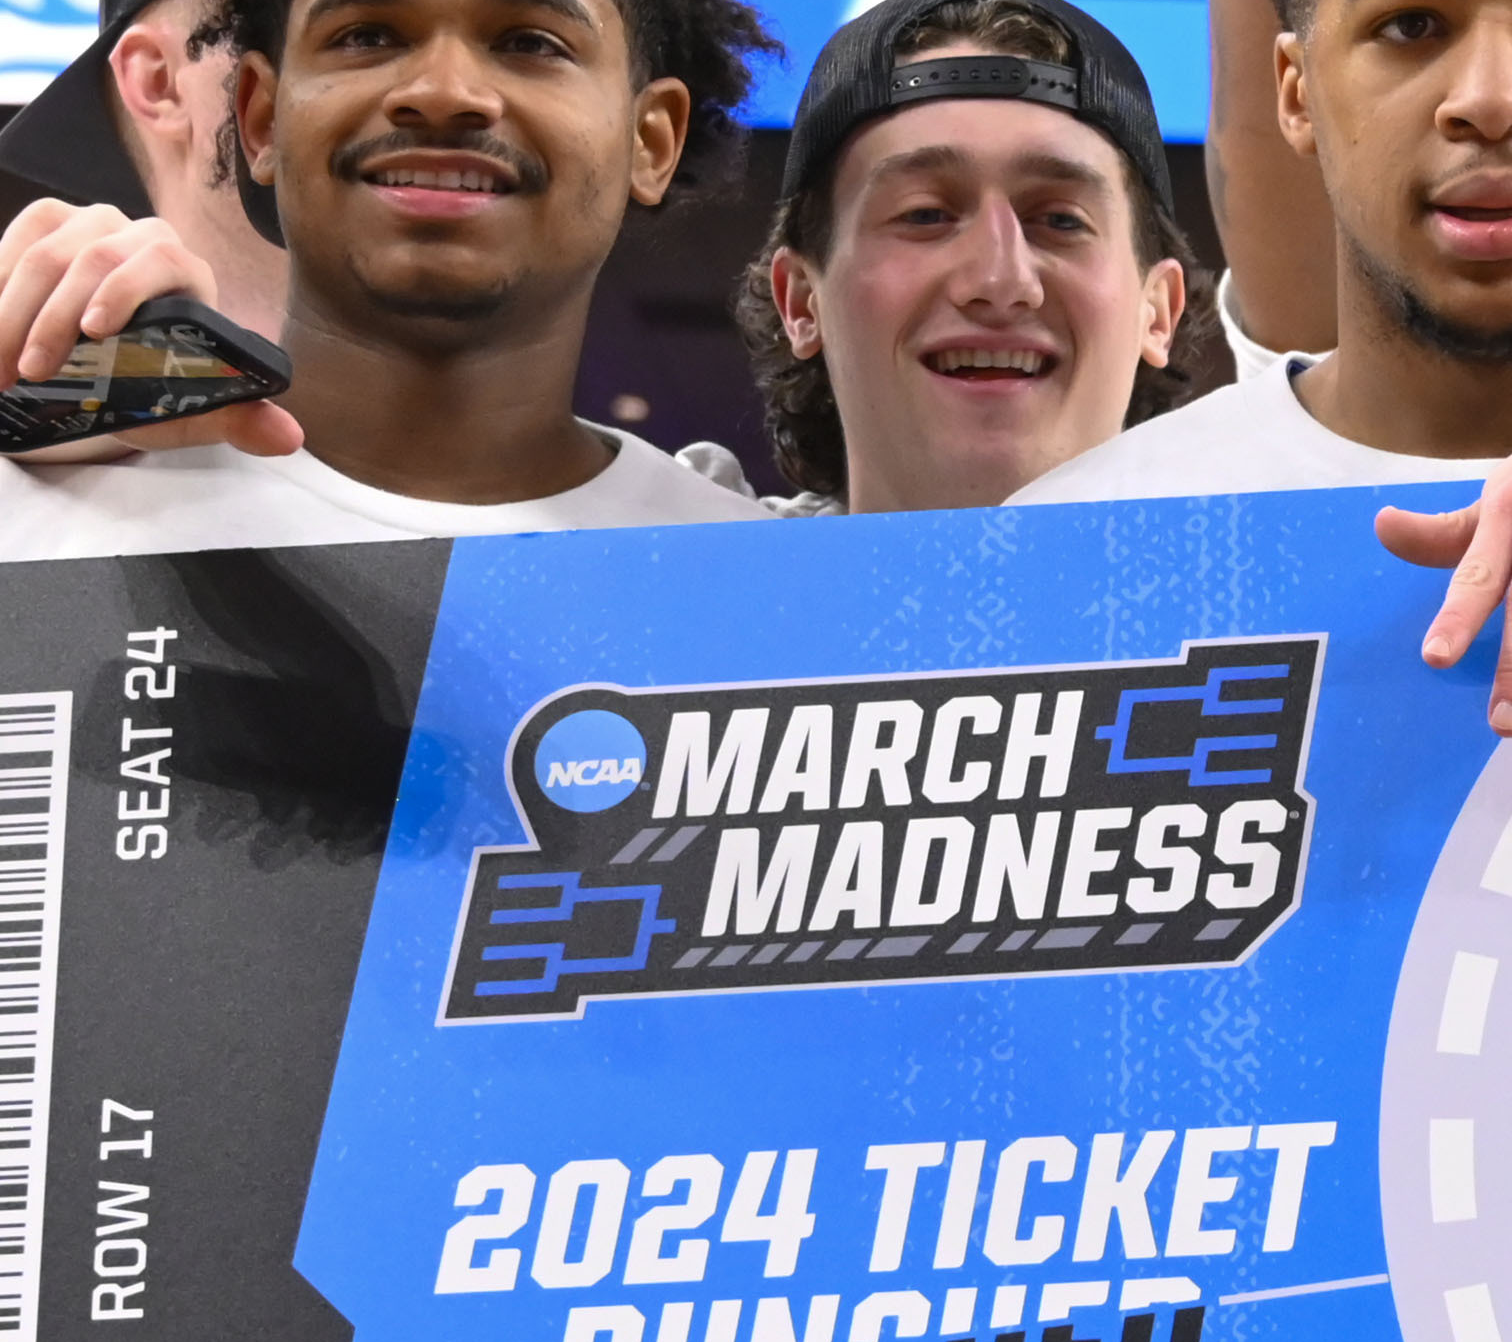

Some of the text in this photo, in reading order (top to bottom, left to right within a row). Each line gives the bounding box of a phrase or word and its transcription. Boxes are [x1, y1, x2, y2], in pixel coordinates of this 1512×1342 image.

[115, 625, 178, 861] SEAT 24
[546, 757, 641, 788] NCAA
[650, 688, 1085, 820] MARCH
[699, 797, 1288, 938] MADNESS
[90, 1098, 154, 1321] ROW 17
[433, 1120, 1338, 1296] 2024 TICKET
